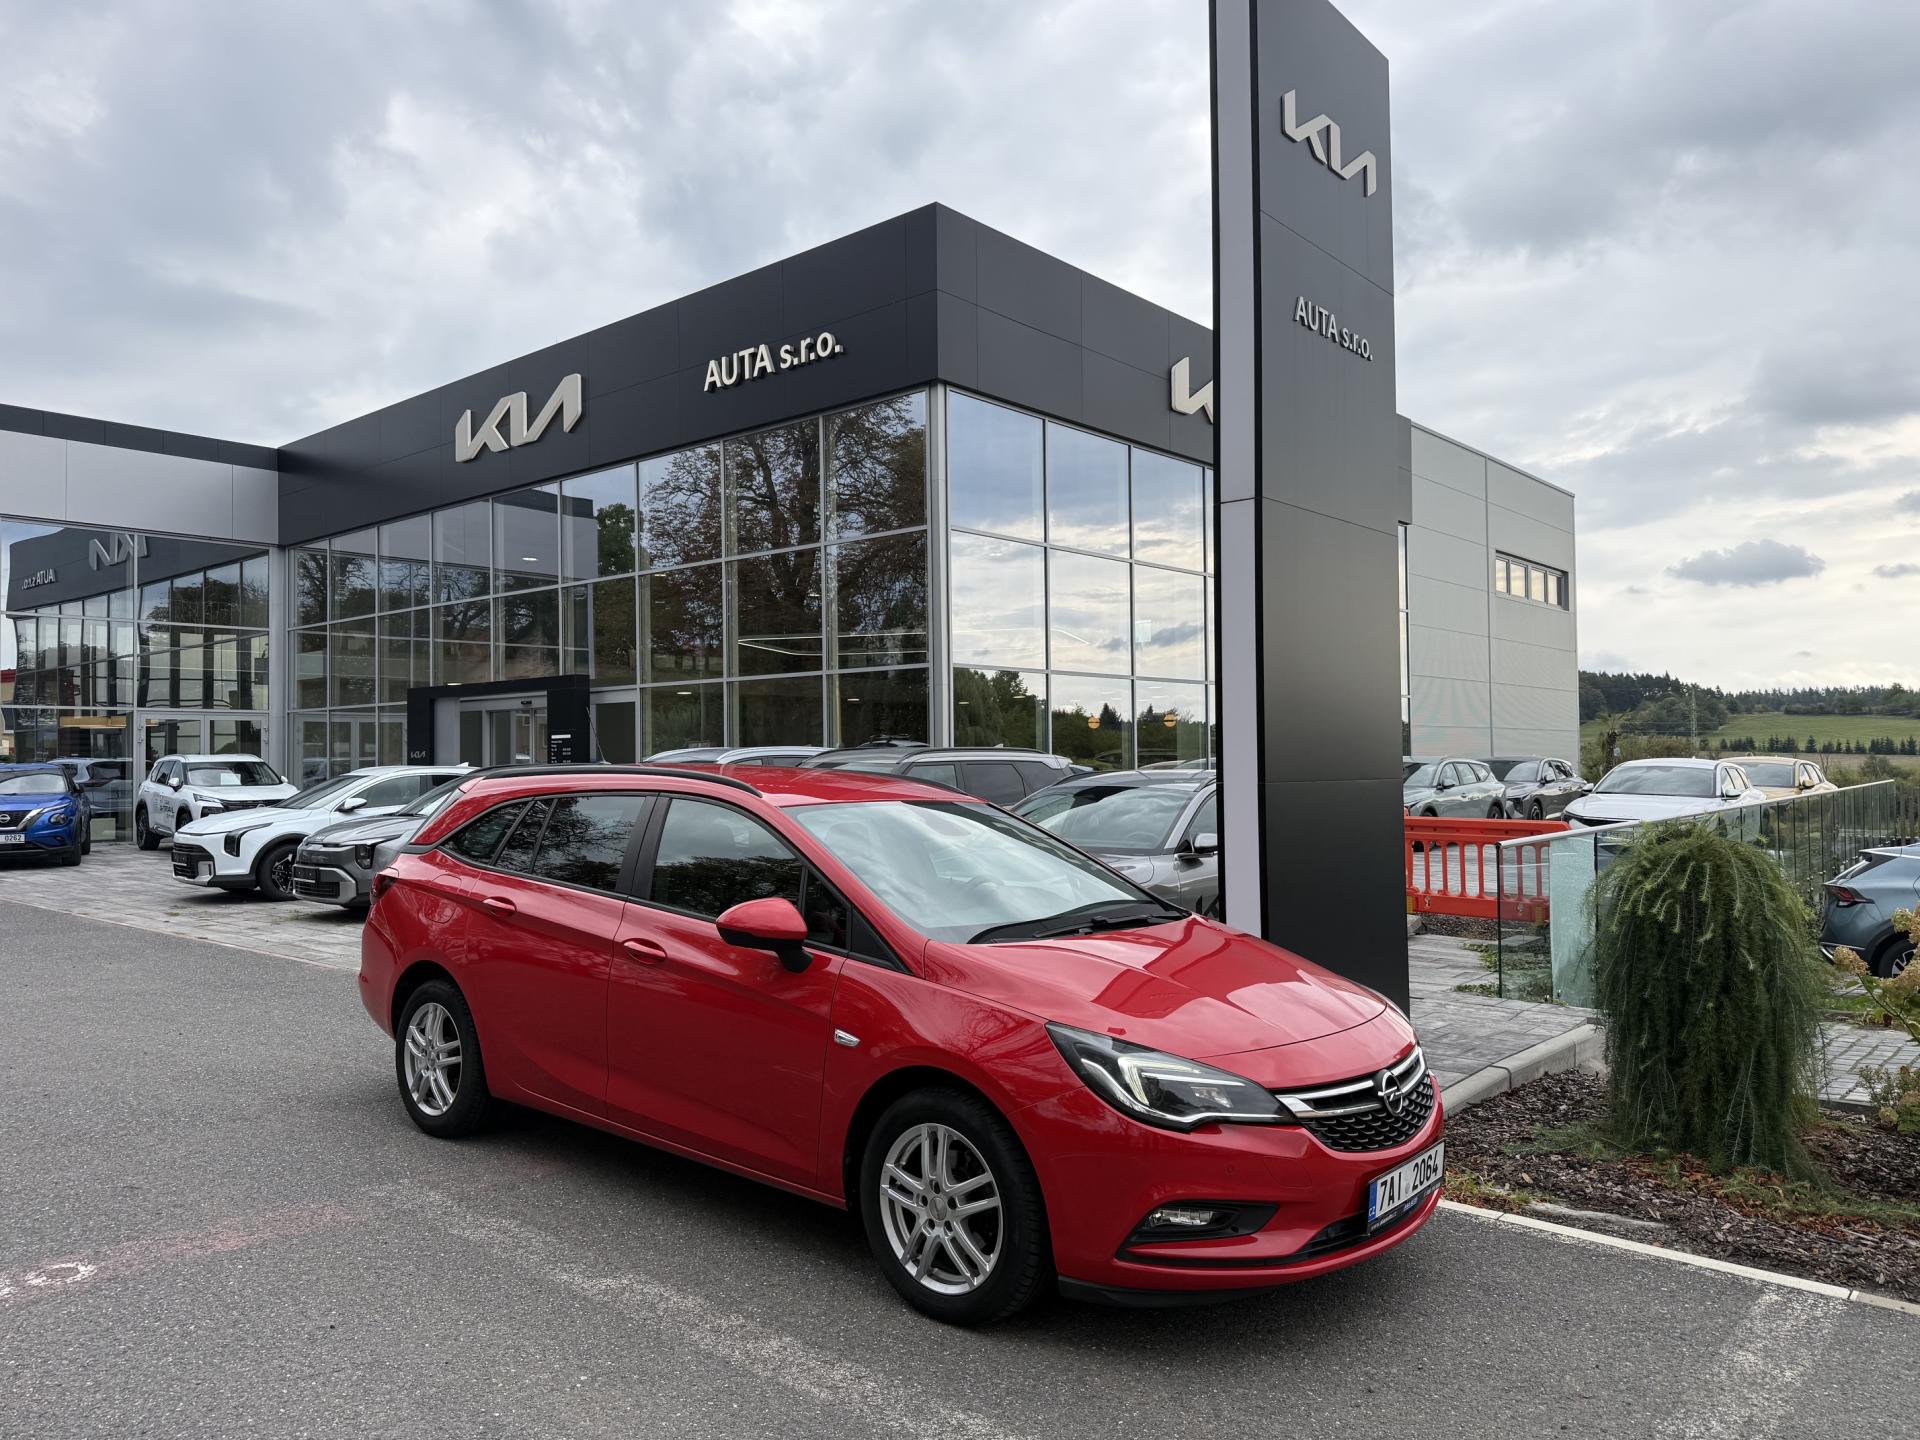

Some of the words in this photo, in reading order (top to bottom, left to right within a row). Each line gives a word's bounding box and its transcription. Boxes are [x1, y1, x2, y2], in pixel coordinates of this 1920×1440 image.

[1280, 88, 1377, 197] KIA
[1294, 295, 1339, 342] AUTA
[1341, 327, 1373, 361] s.r.o.
[703, 343, 776, 392] AUTA
[779, 331, 844, 369] s.r.o.
[455, 372, 582, 462] KIA
[1412, 1149, 1438, 1192] 2064
